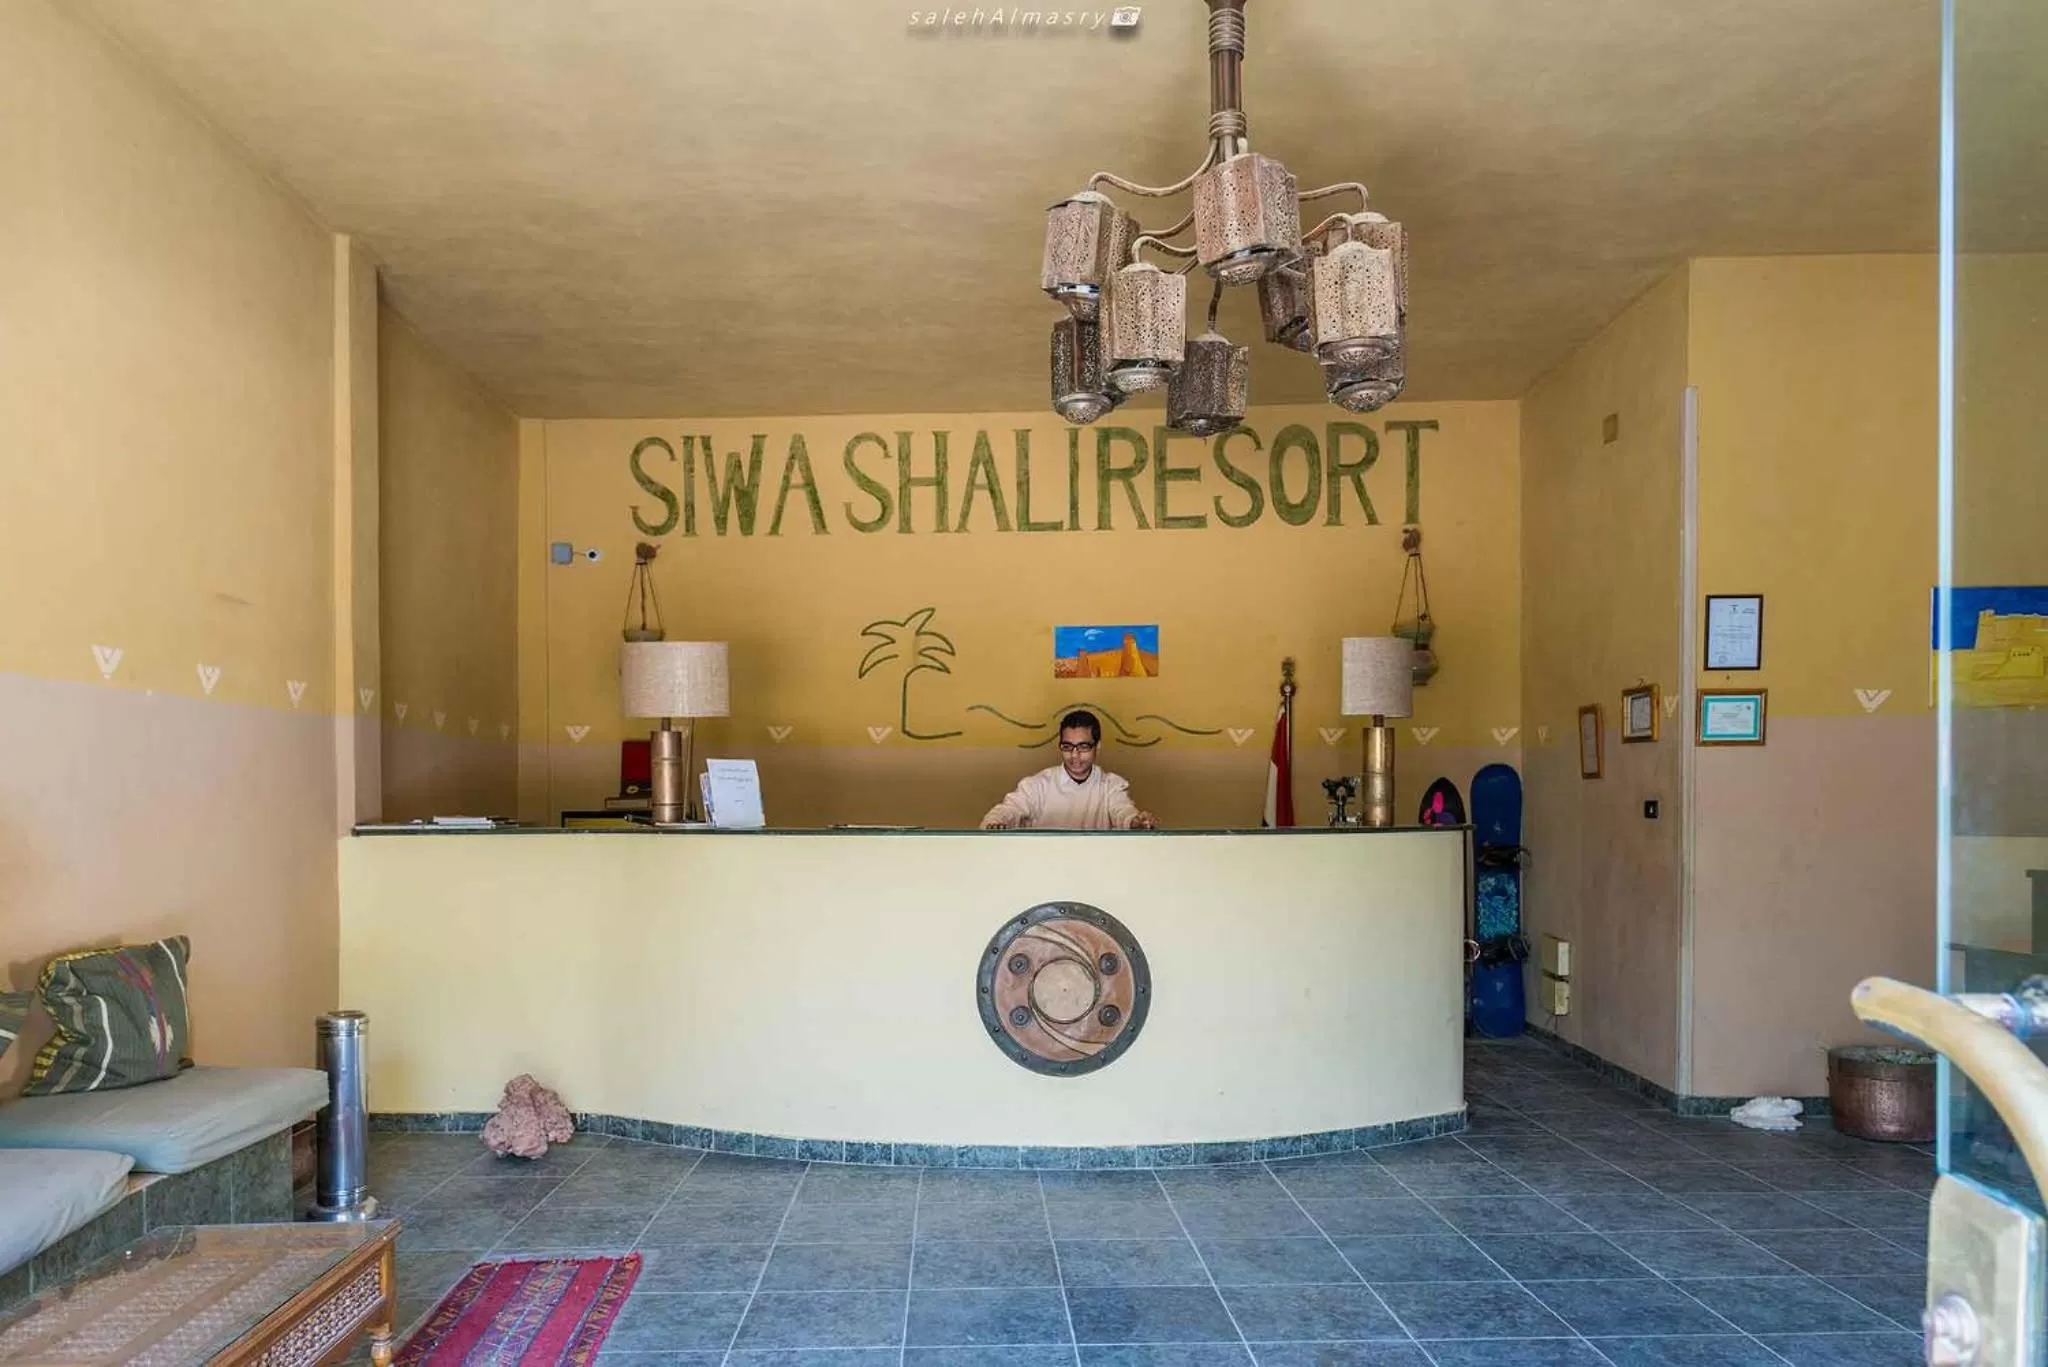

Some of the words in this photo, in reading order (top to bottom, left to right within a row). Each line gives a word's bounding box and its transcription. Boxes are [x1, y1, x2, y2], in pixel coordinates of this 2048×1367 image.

[629, 433, 829, 538] SIWA
[843, 428, 1083, 534] SHALI
[1094, 420, 1440, 531] RESORT
